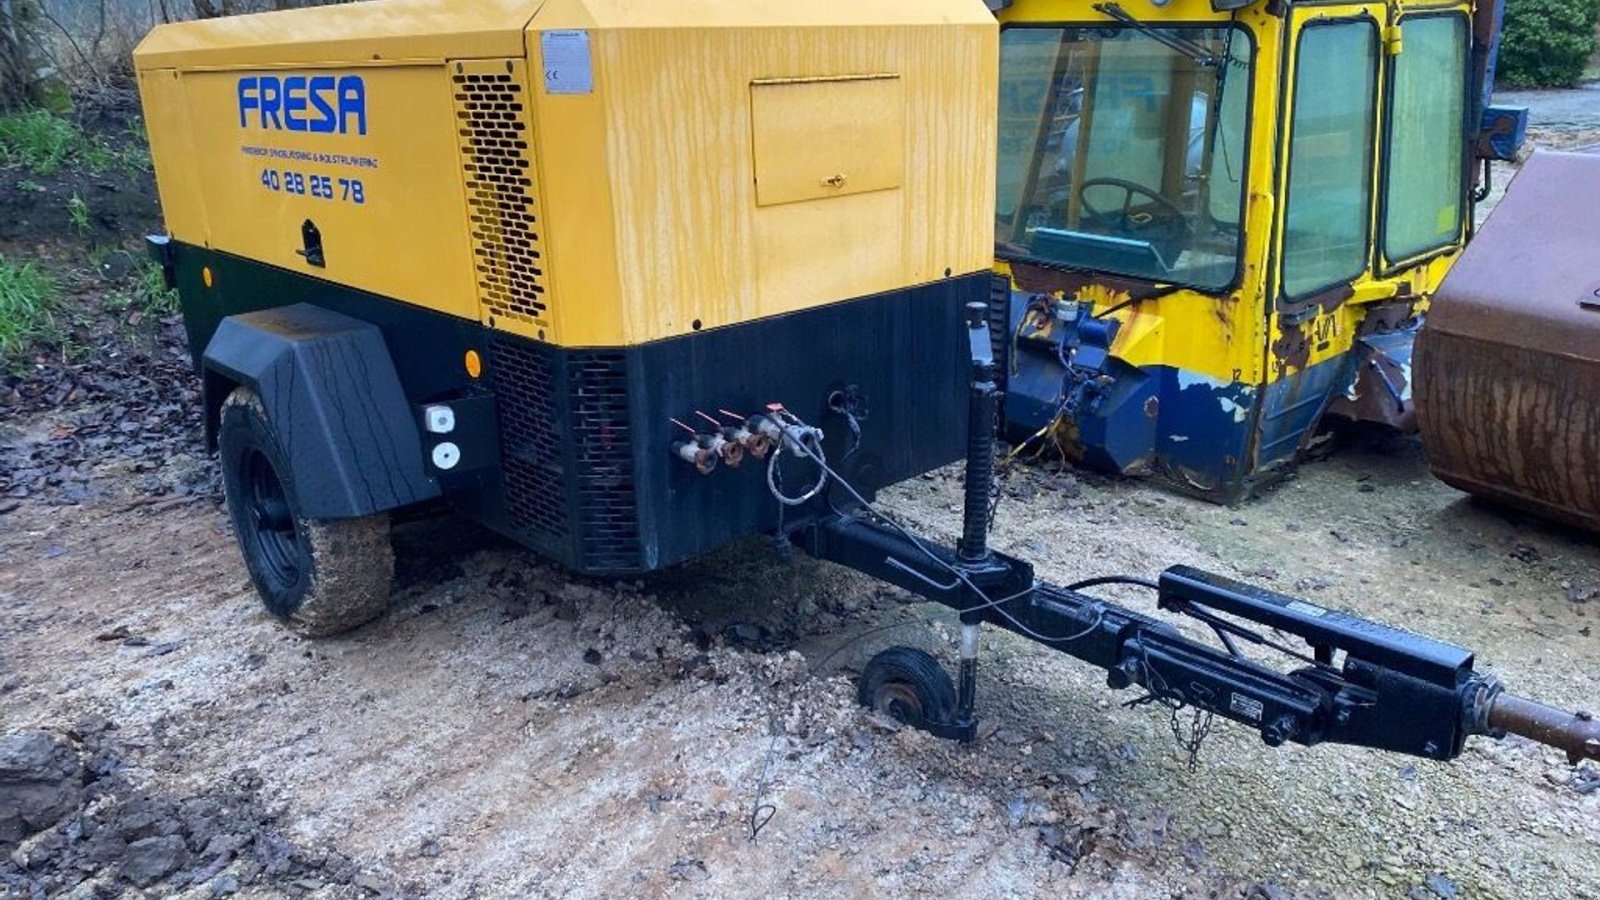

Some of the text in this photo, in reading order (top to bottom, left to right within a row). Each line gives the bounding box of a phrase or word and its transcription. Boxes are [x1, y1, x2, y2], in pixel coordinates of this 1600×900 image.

[238, 75, 366, 135] FRESA
[261, 168, 365, 204] 40 28 25 78
